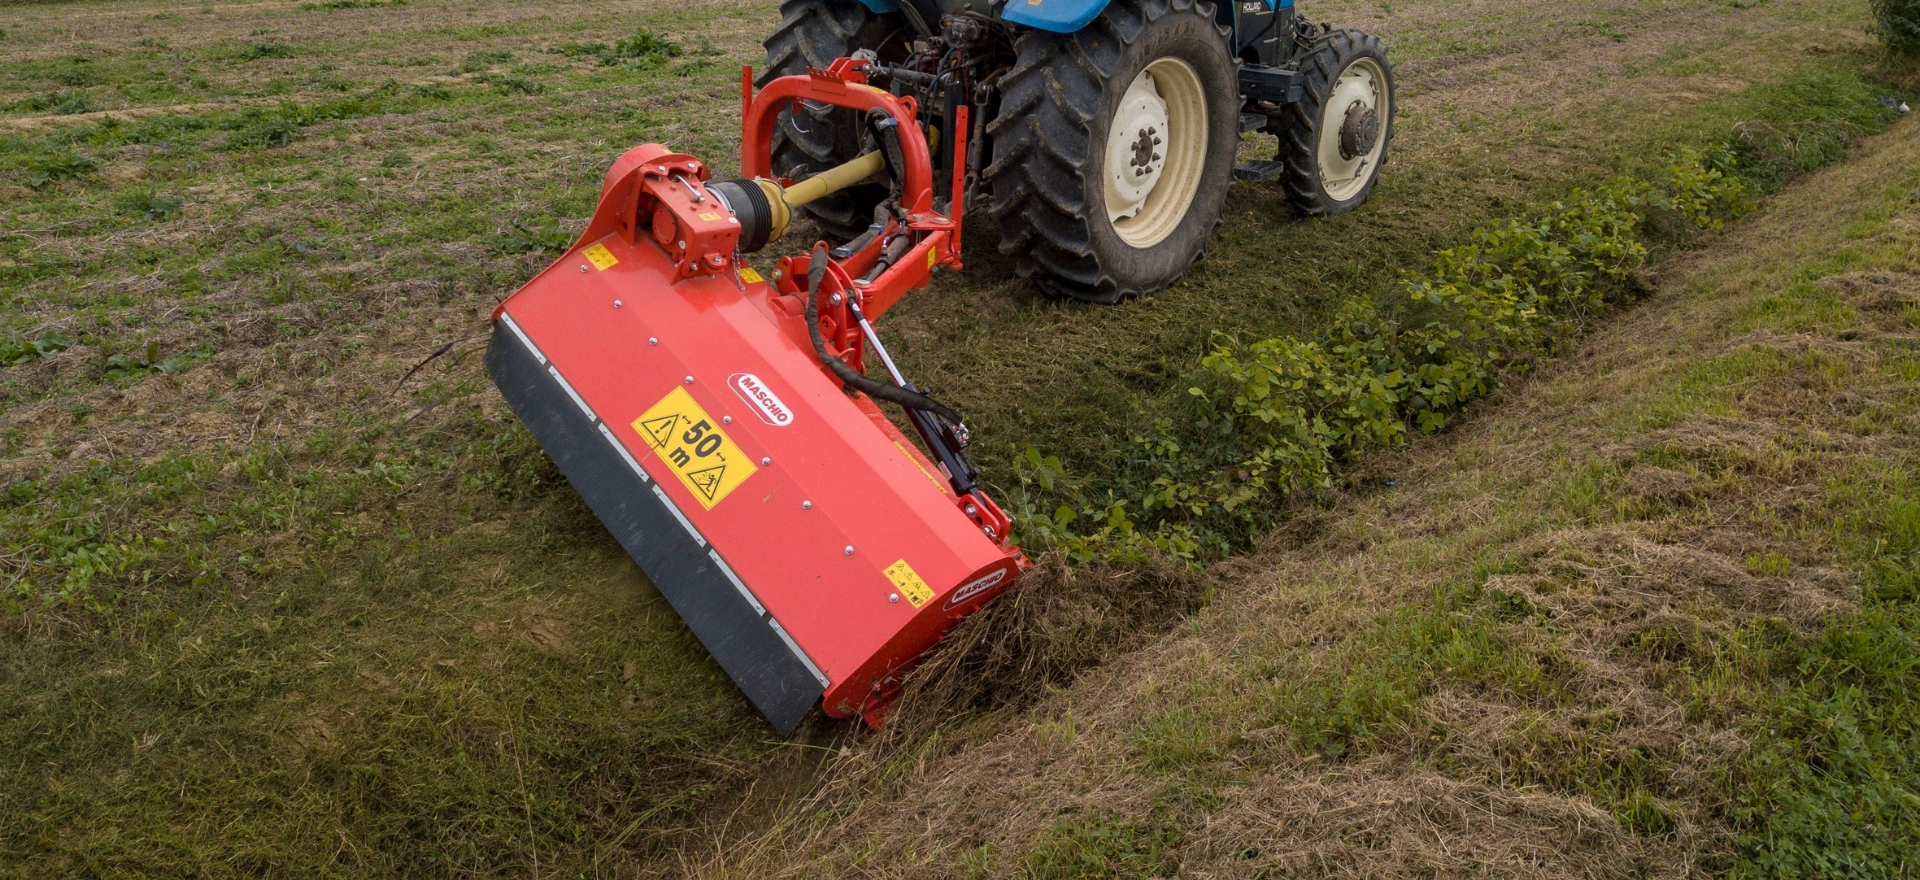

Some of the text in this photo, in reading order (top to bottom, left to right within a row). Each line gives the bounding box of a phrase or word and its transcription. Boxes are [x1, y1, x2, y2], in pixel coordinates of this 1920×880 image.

[741, 377, 788, 423] MASCHIO
[682, 419, 722, 458] 50
[668, 446, 691, 469] m
[954, 572, 1003, 600] MASCHIO
